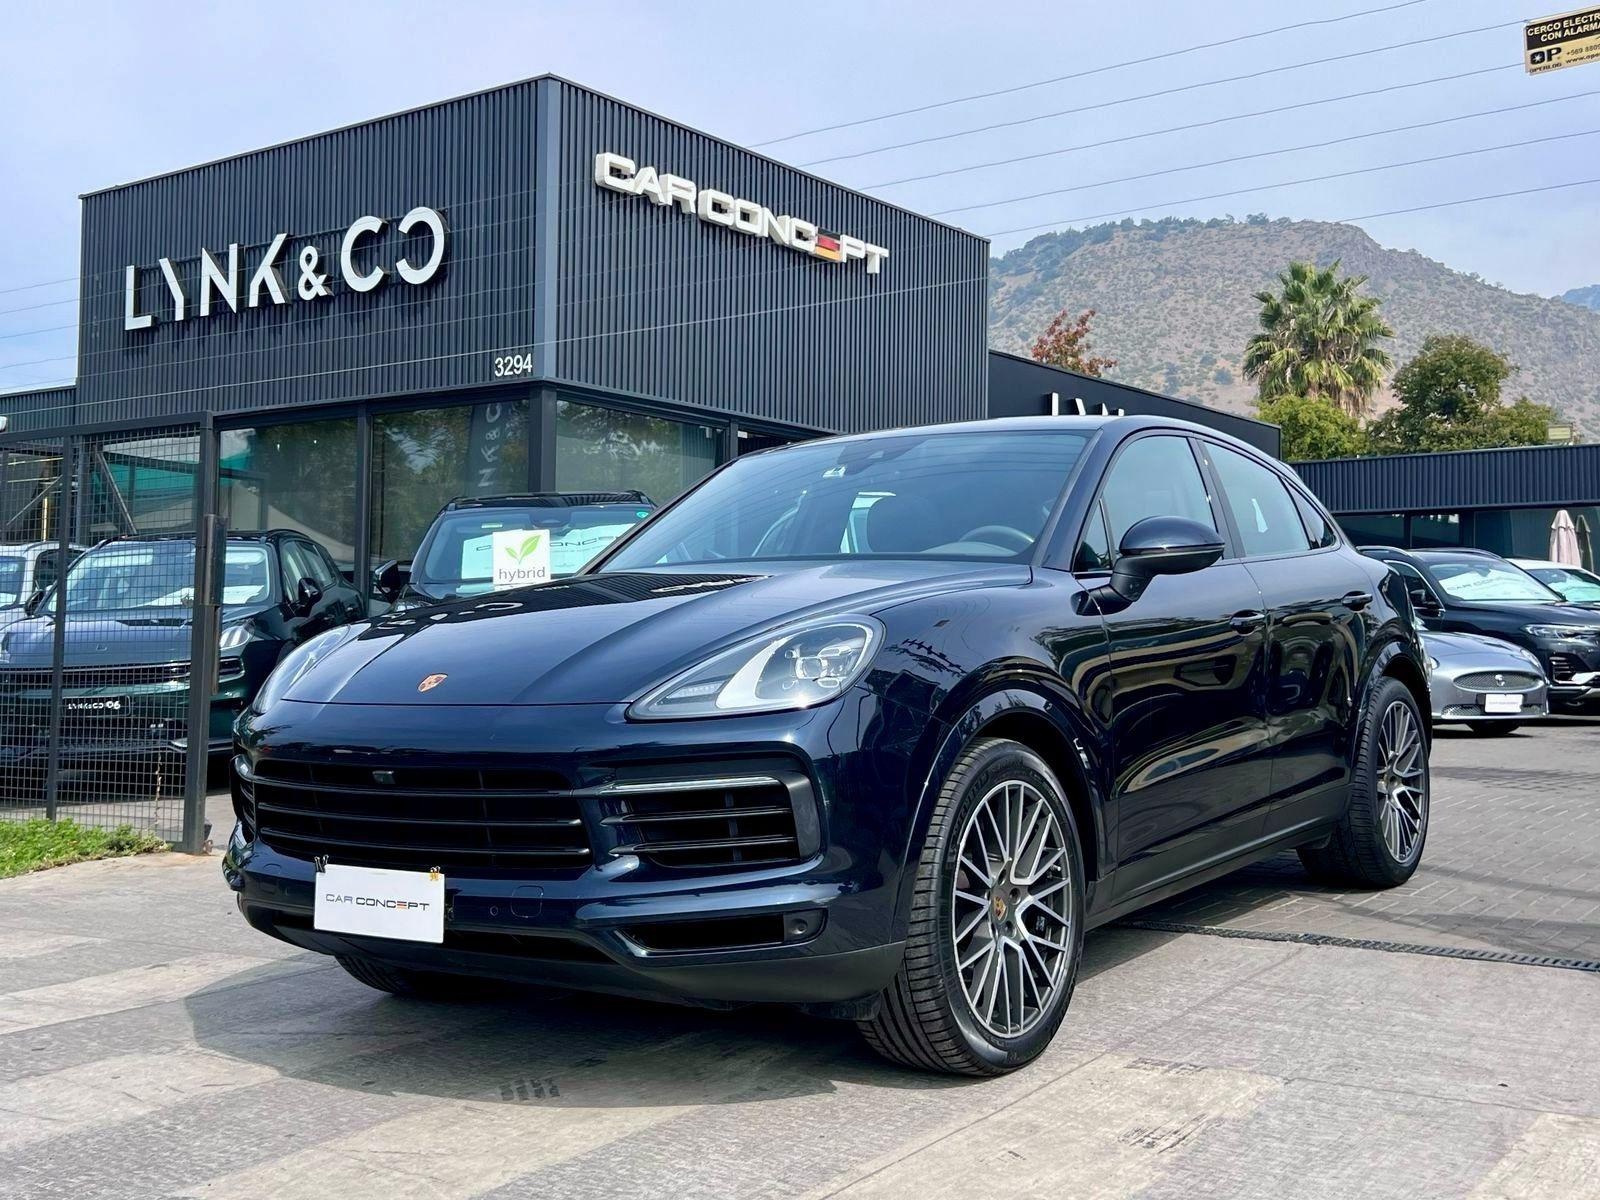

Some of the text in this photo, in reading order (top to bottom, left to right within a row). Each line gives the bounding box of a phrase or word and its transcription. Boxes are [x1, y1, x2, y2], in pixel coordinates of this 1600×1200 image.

[1527, 22, 1561, 36] CERCO
[1540, 31, 1561, 42] CON
[594, 151, 890, 275] CAR CONCEPT
[494, 353, 533, 377] 3294
[498, 566, 546, 583] hybrid
[105, 700, 121, 710] 06
[325, 893, 430, 911] CAR CONCEPT
